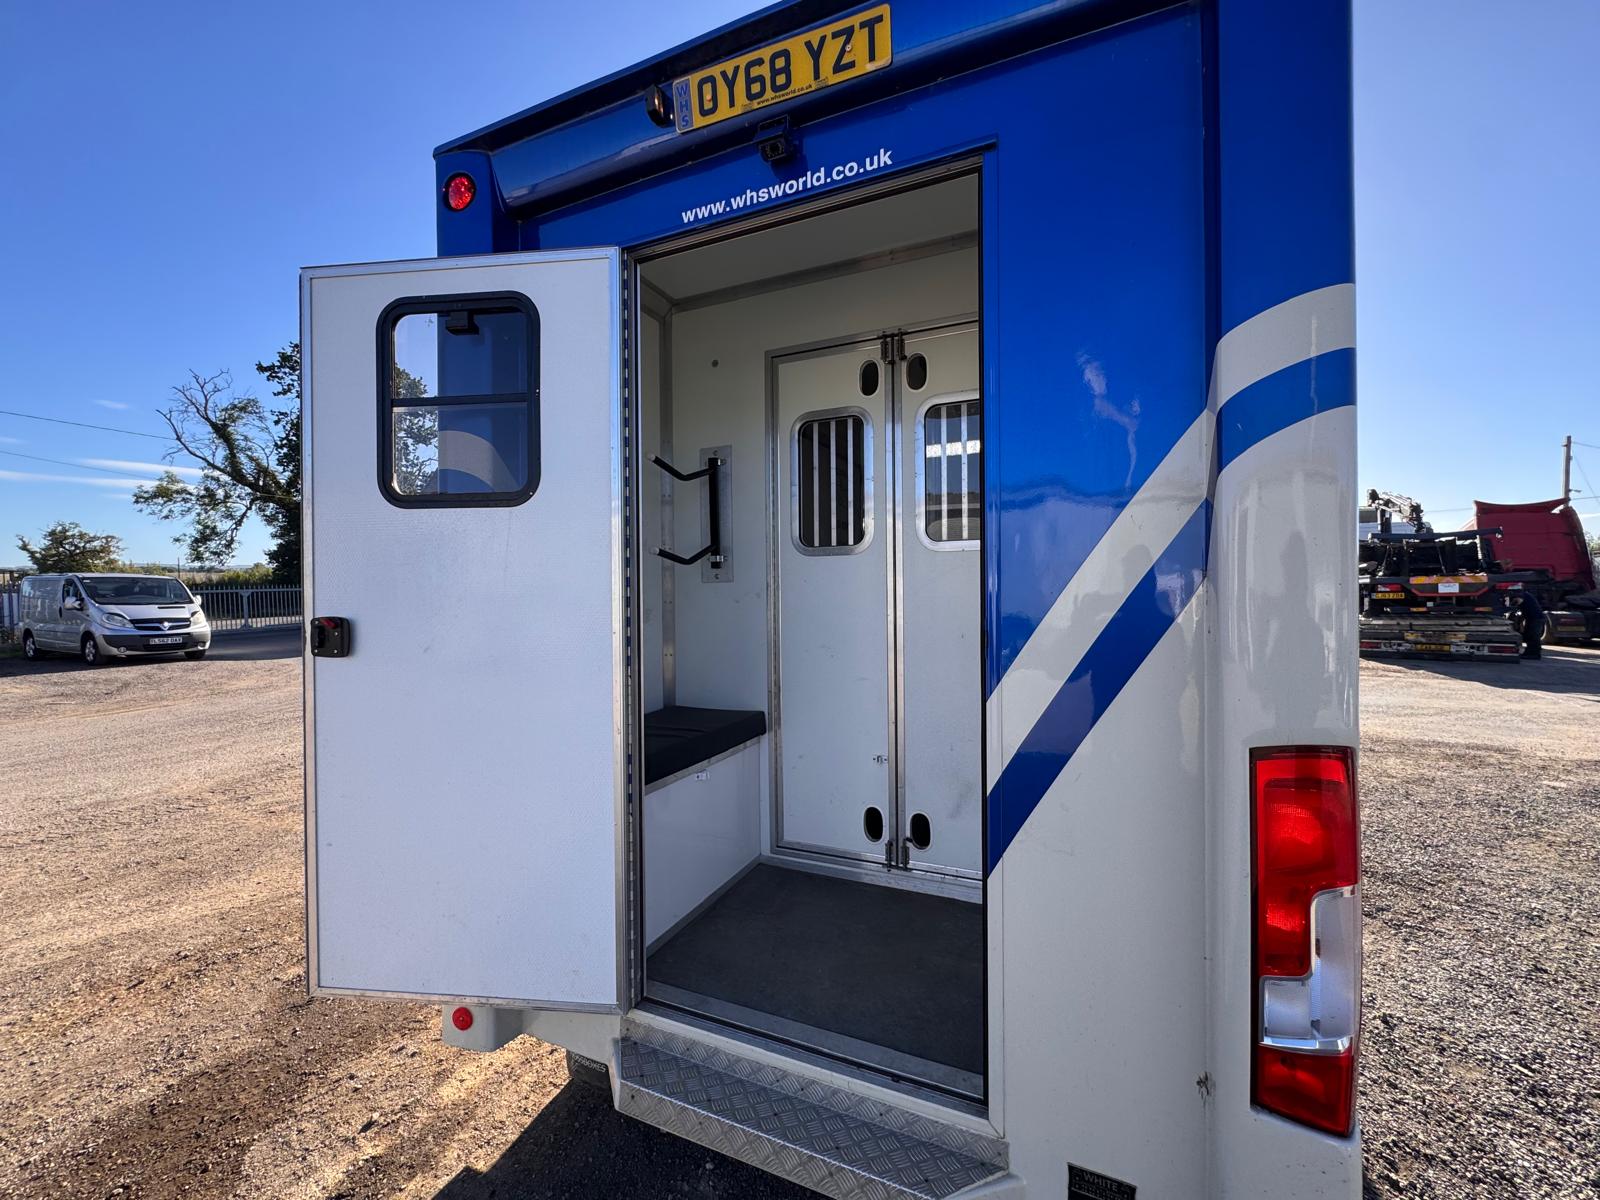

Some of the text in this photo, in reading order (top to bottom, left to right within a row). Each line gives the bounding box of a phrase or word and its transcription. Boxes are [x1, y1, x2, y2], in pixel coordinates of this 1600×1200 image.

[697, 14, 884, 118] OY68 YZT
[676, 85, 689, 128] WHS
[756, 83, 813, 106] www.whsworld.co.uk
[681, 147, 893, 224] www.whsworld.co.uk
[1083, 1171, 1118, 1191] WHITE
